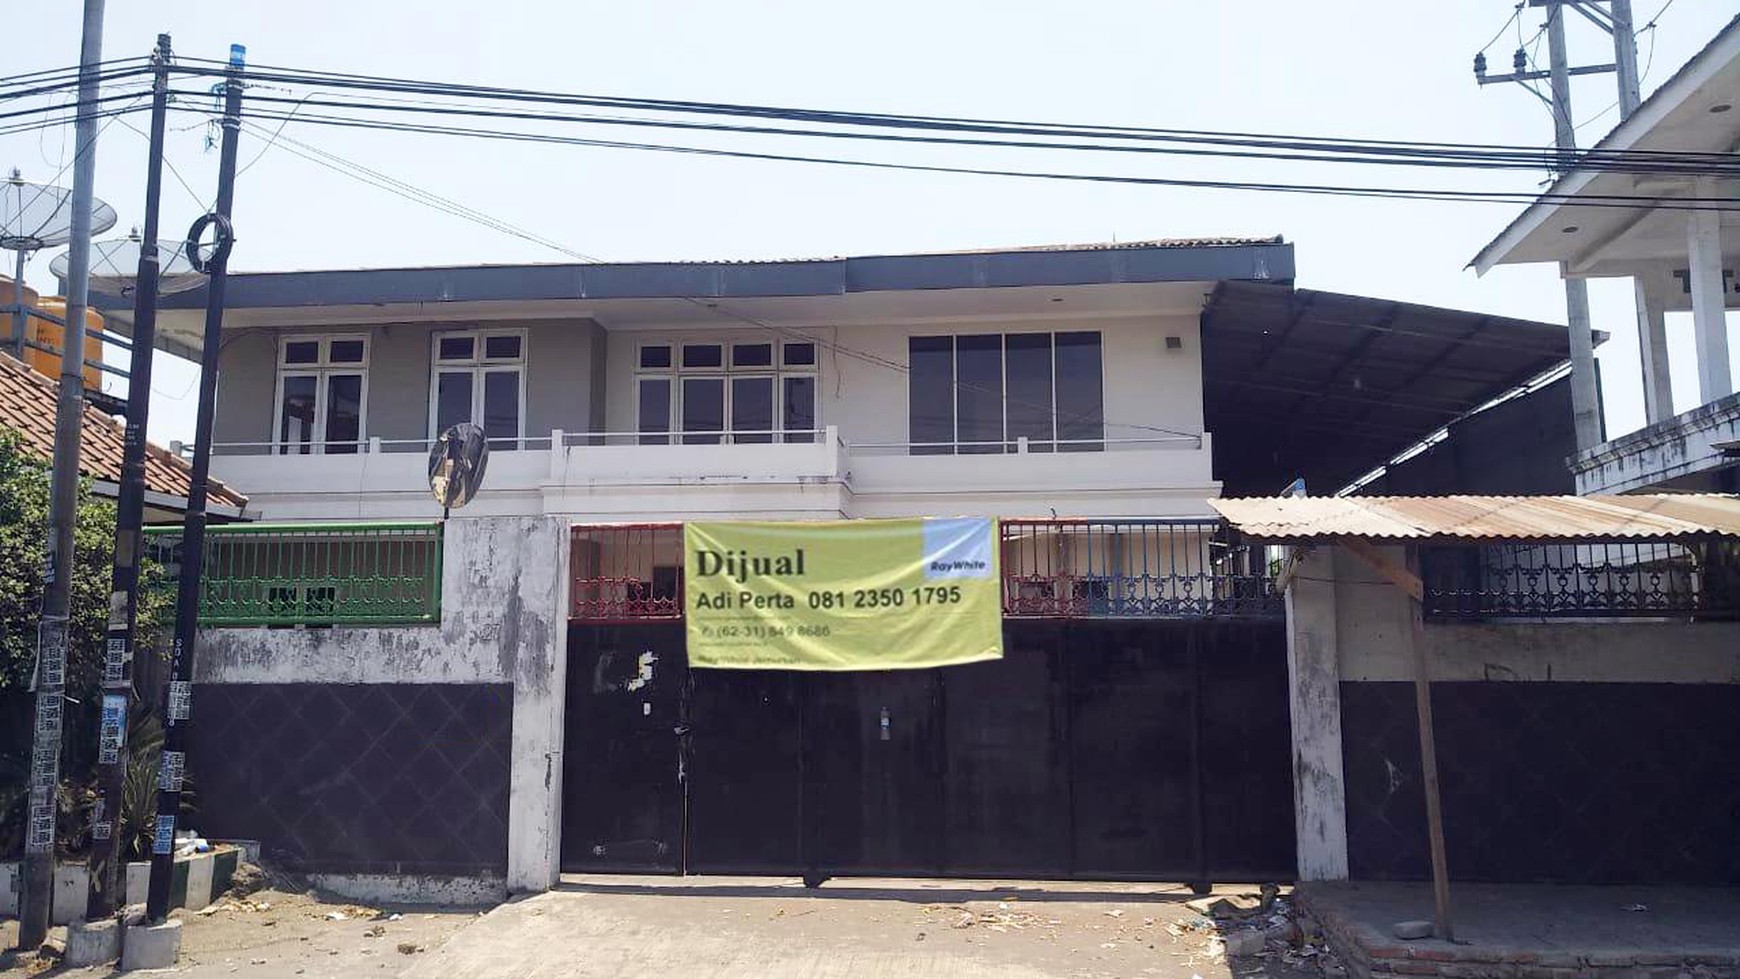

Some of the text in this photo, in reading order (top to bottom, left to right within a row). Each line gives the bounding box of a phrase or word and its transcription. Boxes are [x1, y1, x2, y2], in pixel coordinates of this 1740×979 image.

[696, 549, 805, 583] Dijual
[696, 586, 961, 610] Adi Perta 081 2350 1795
[716, 626, 766, 638] (62-31)
